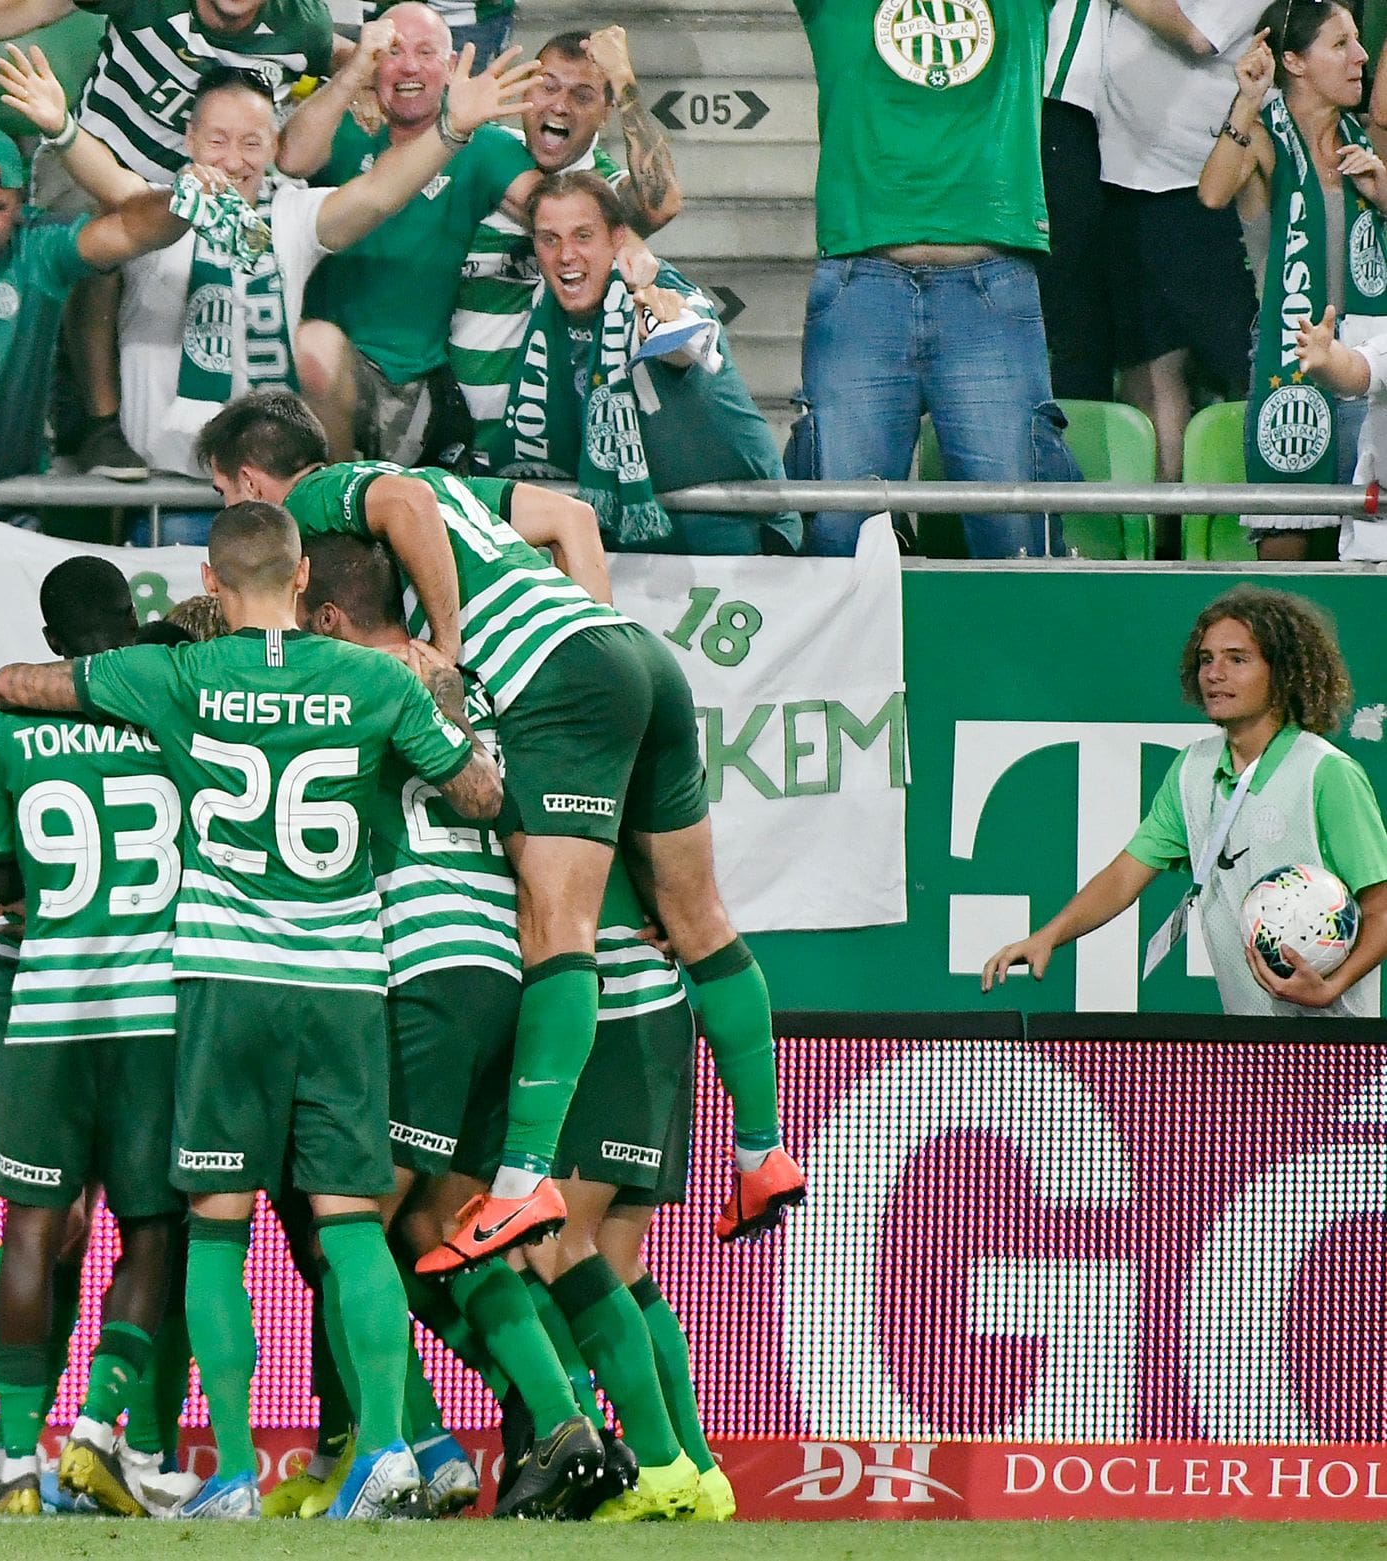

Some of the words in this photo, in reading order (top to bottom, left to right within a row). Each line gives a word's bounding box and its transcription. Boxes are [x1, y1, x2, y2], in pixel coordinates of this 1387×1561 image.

[690, 94, 732, 125] 05
[505, 329, 550, 461] ZÖLD
[663, 587, 763, 668] 18
[199, 688, 352, 726] HEISTER
[695, 691, 906, 803] KEM
[17, 774, 182, 919] 93
[190, 733, 360, 879] 26
[1002, 1453, 1254, 1497] DOCLER
